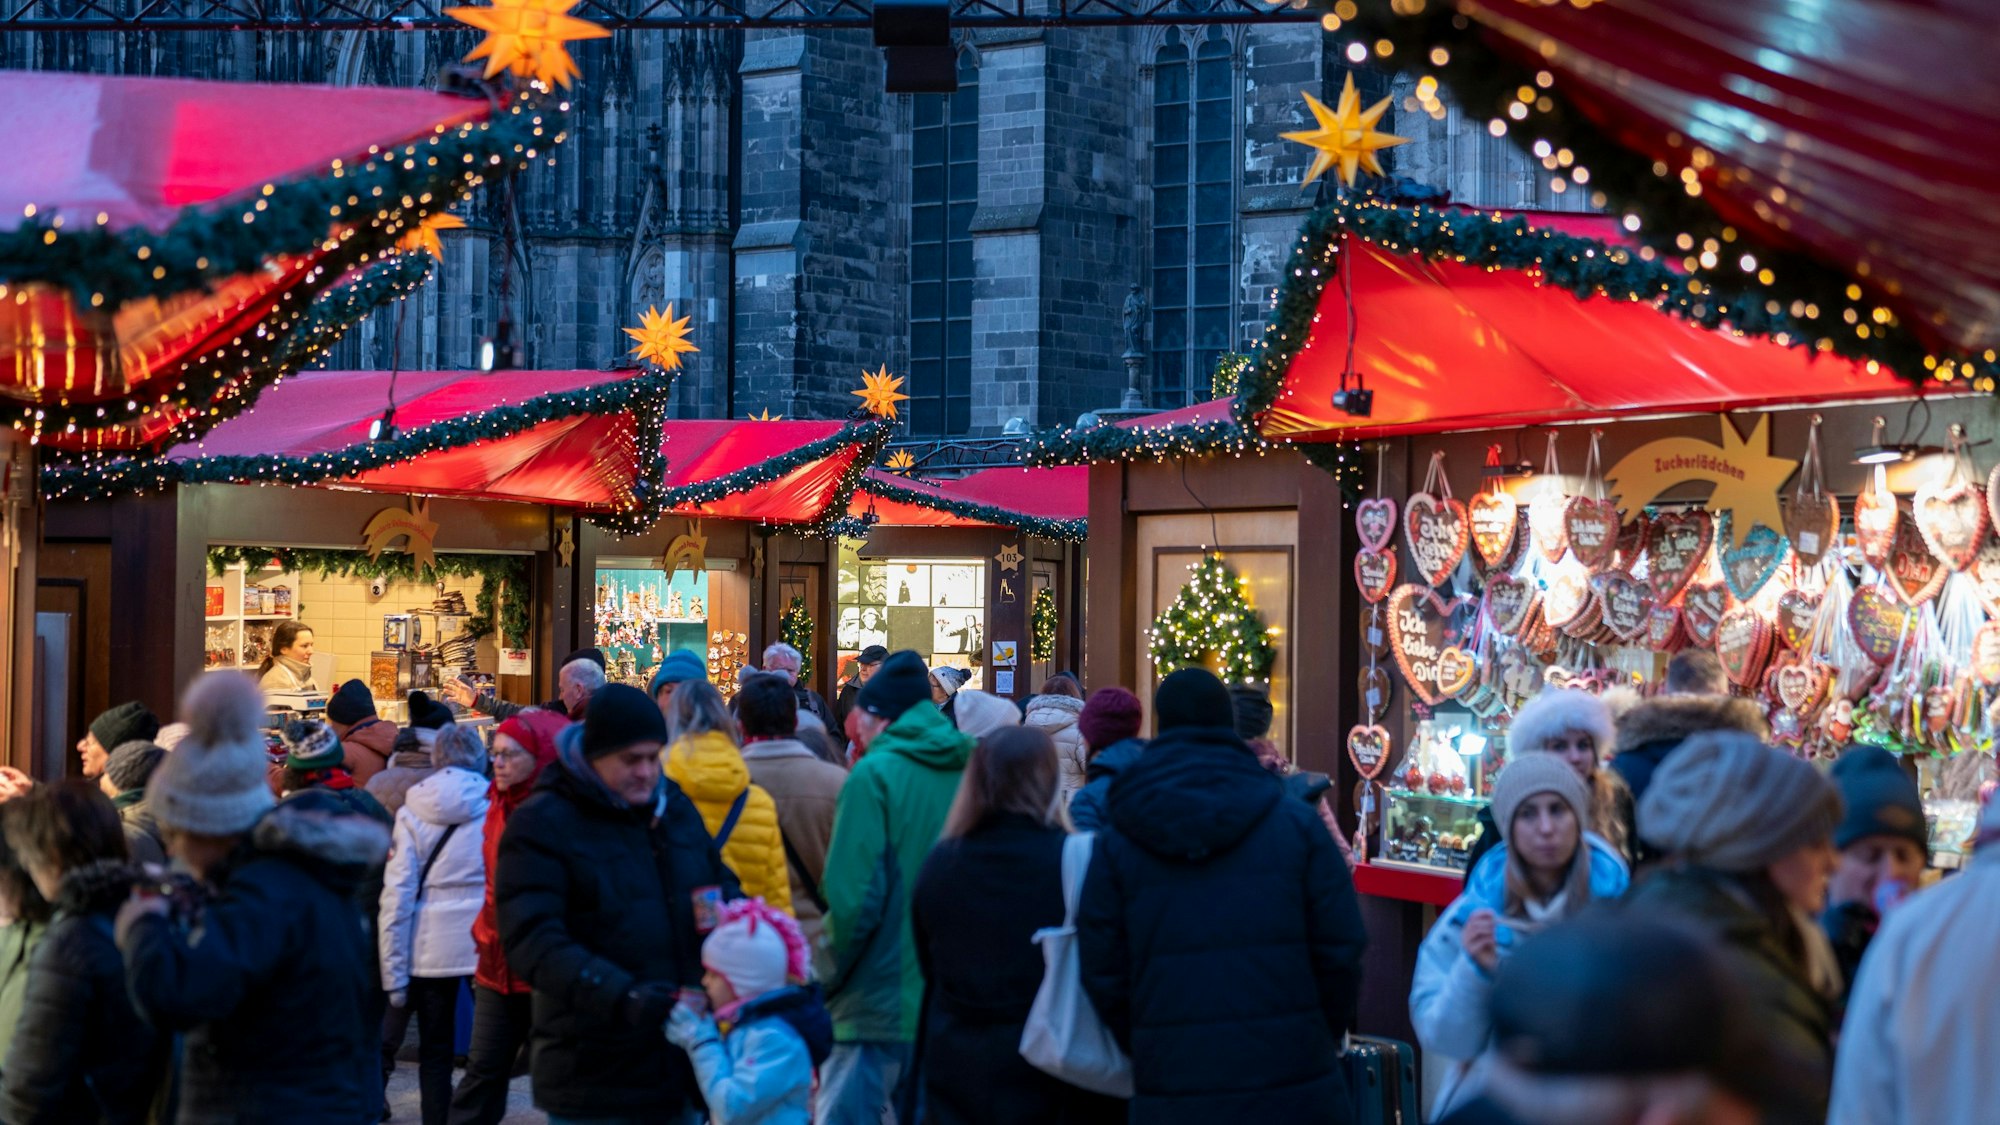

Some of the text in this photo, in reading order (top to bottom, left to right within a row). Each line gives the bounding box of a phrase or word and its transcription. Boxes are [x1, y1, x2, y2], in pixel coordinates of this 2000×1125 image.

[1654, 453, 1745, 481] Zuckerlädchen
[1001, 553, 1017, 563] 103
[1398, 609, 1428, 634] Ich
[1401, 633, 1438, 661] liebe
[1413, 661, 1438, 682] Dic
